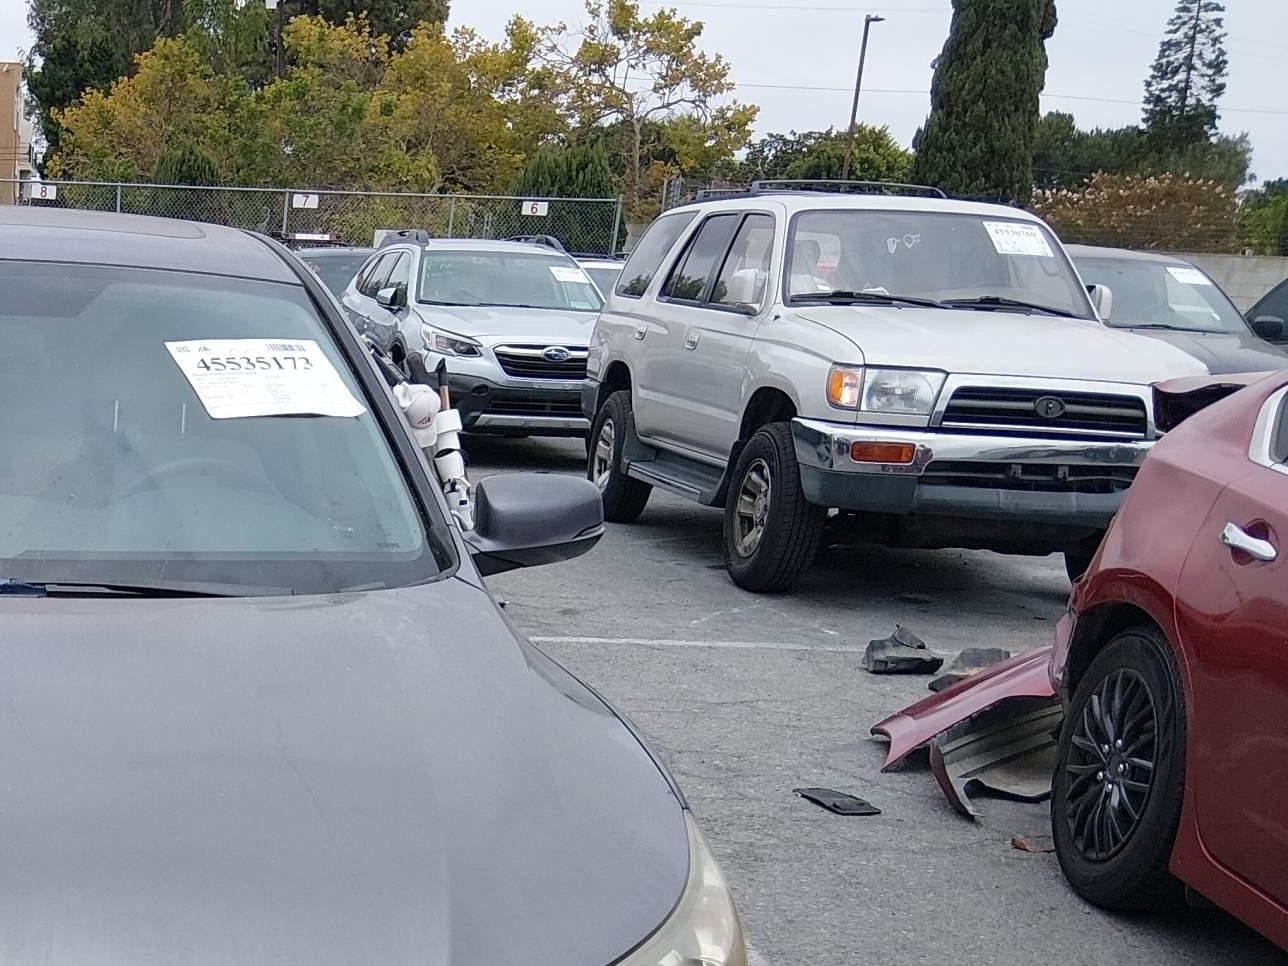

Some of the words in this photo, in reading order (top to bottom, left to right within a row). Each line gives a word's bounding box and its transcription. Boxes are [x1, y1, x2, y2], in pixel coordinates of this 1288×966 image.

[40, 186, 48, 198] 8
[303, 195, 310, 207] 7
[531, 203, 539, 215] 6
[197, 356, 313, 371] 45535173
